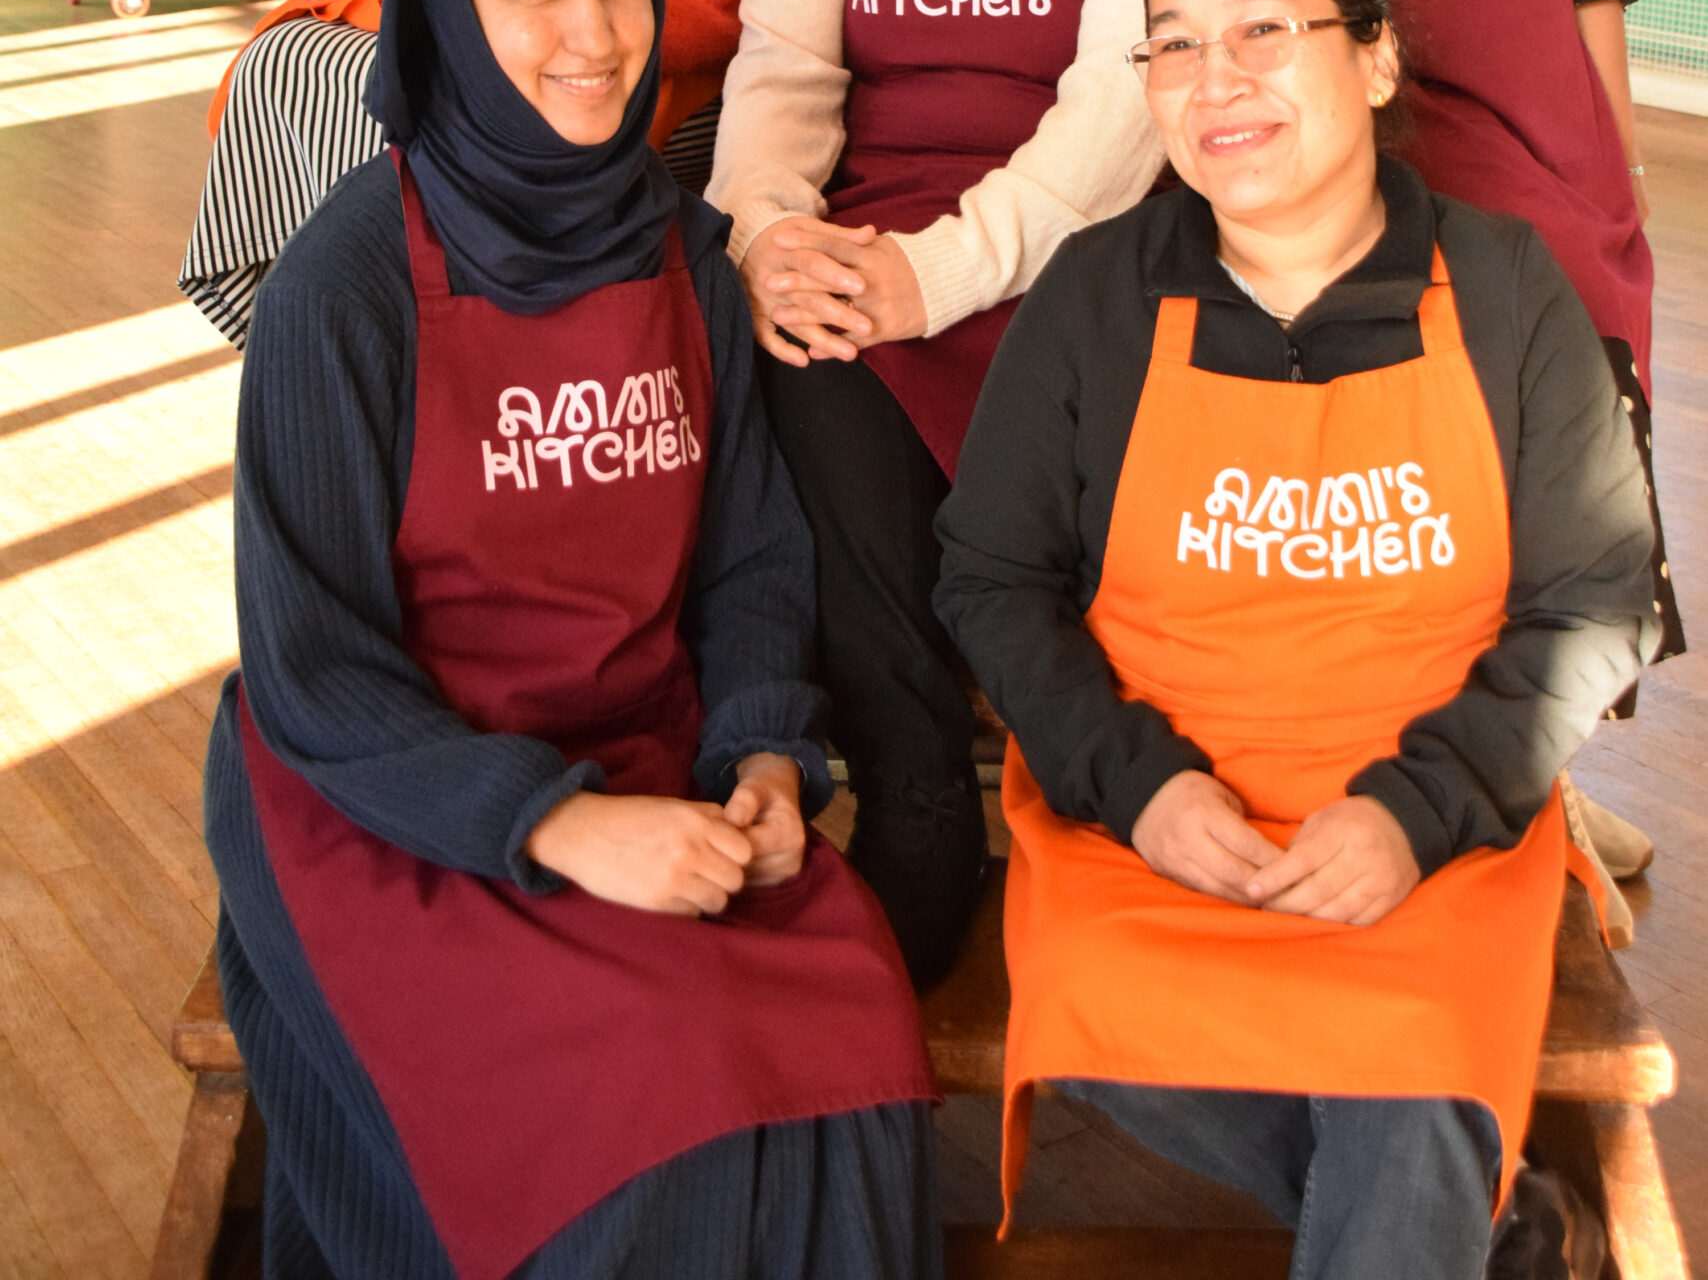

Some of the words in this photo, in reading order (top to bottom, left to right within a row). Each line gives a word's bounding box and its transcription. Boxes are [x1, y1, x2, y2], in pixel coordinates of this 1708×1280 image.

[498, 366, 684, 437] AMMI'S
[481, 414, 701, 491] KITCHEN
[1204, 462, 1430, 531] AMMI'S
[1176, 512, 1455, 579] KITCHEN
